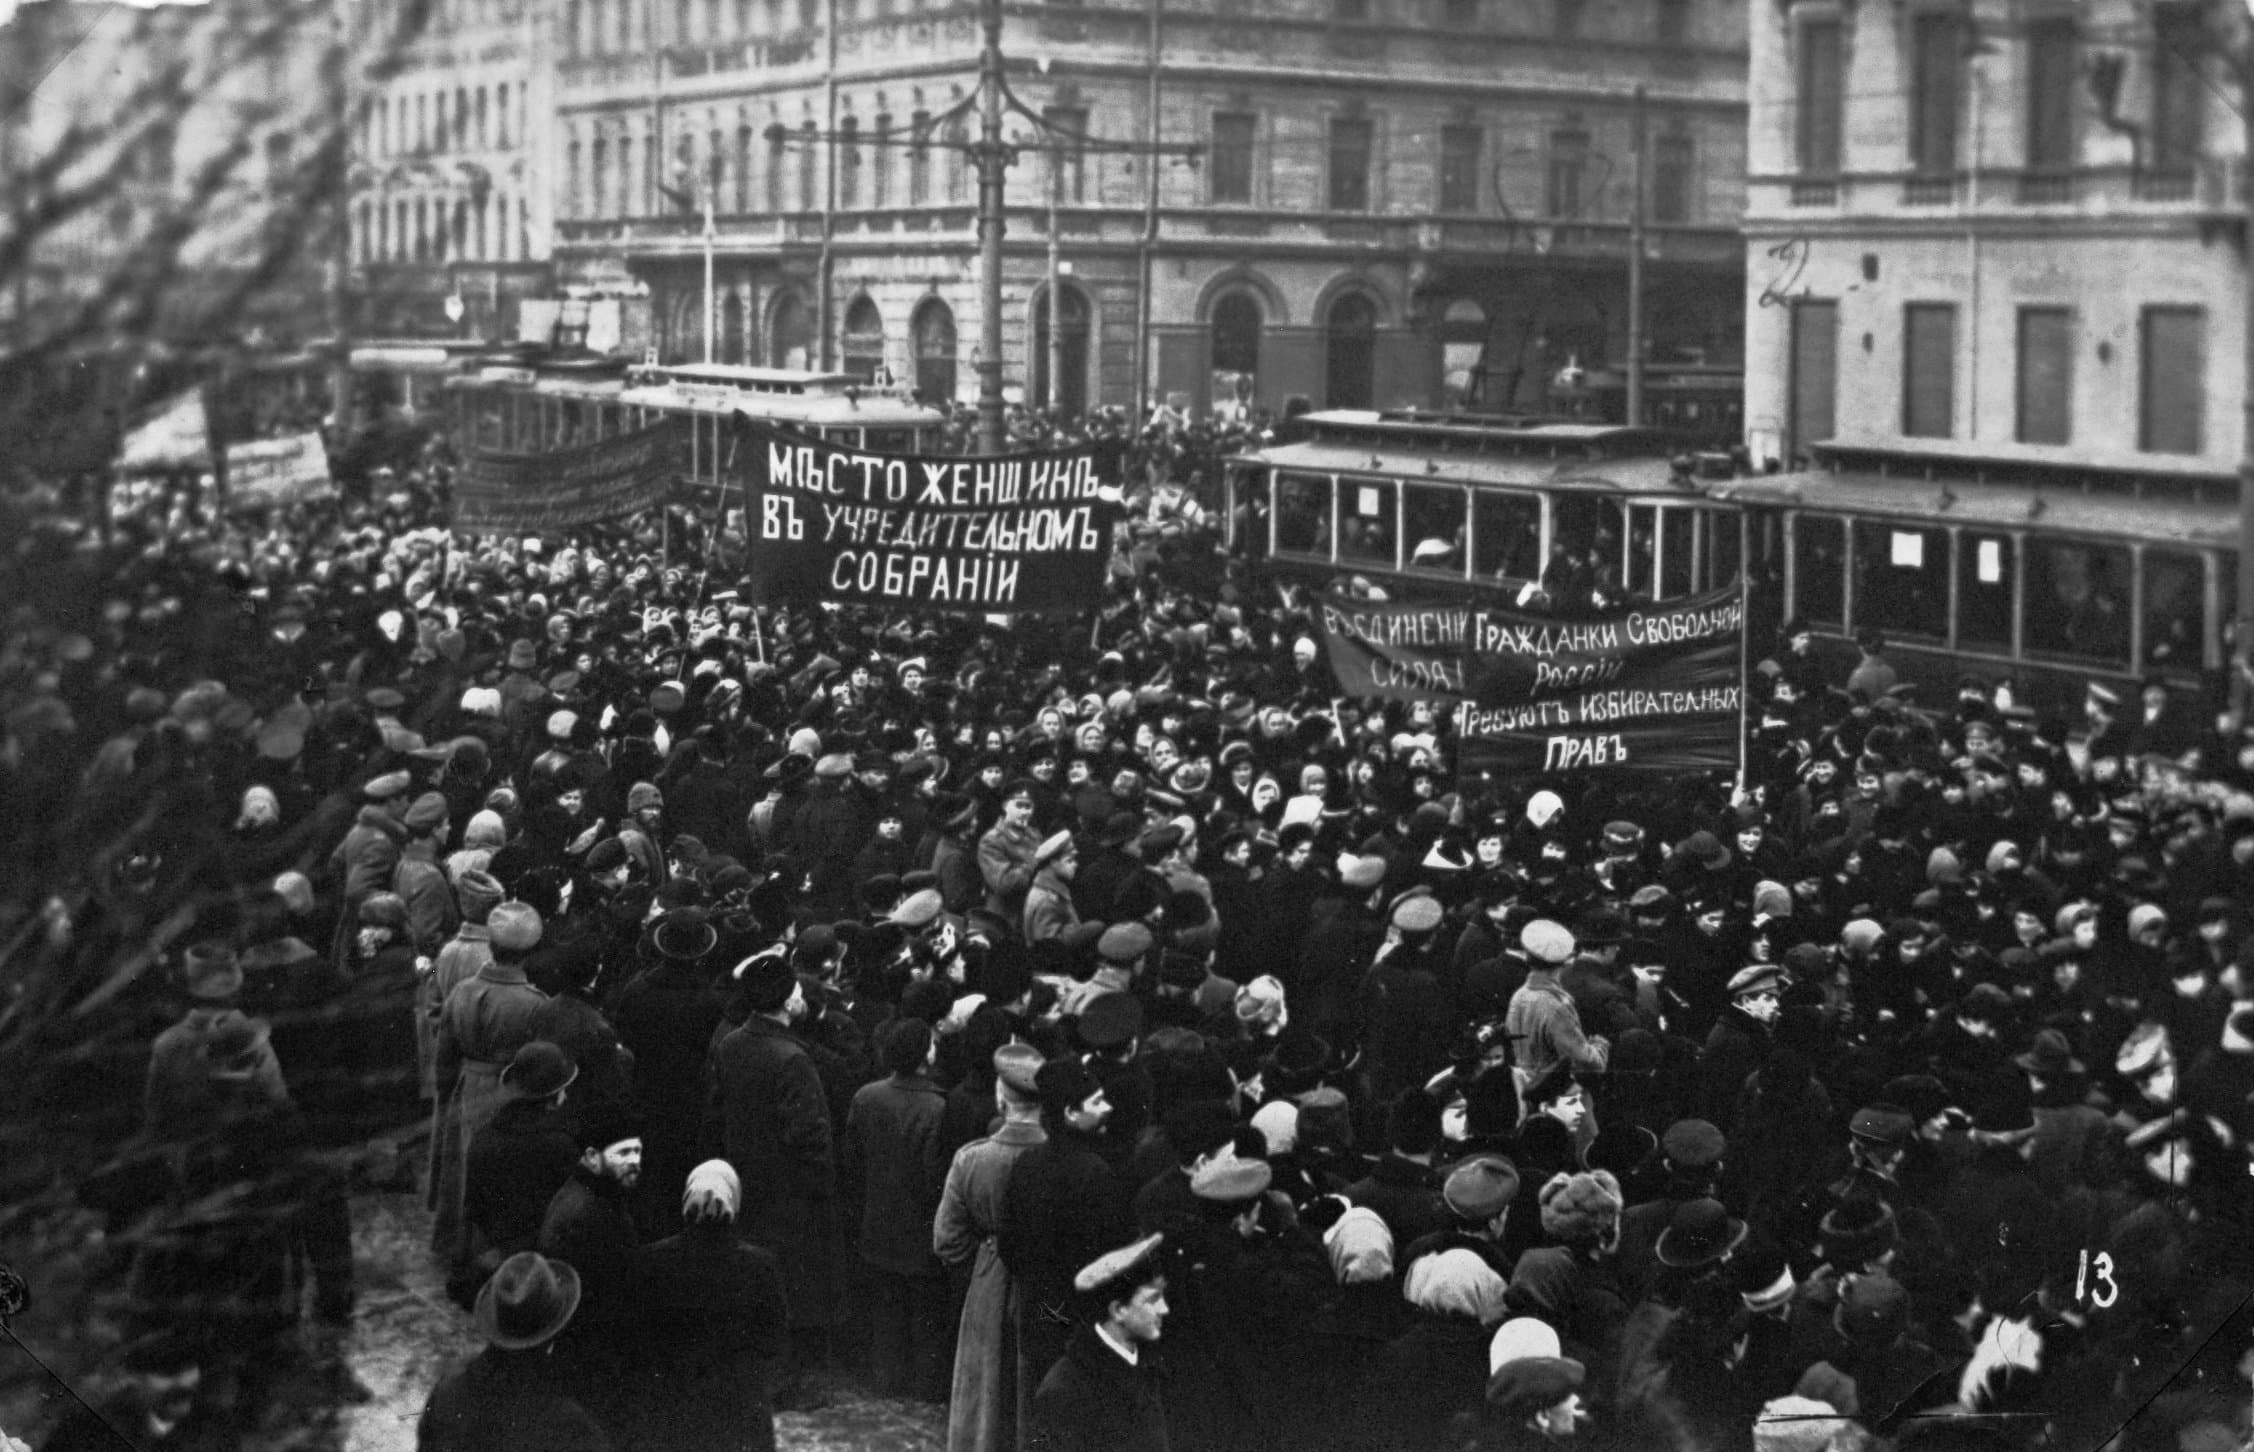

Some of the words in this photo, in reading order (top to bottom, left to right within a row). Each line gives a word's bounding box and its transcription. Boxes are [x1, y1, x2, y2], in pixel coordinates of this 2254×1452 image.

[769, 441, 908, 501] МѢСТО
[762, 493, 804, 540] ВЪ
[823, 503, 1098, 552] УЧРЕДИТЕЛЬНОМЪ
